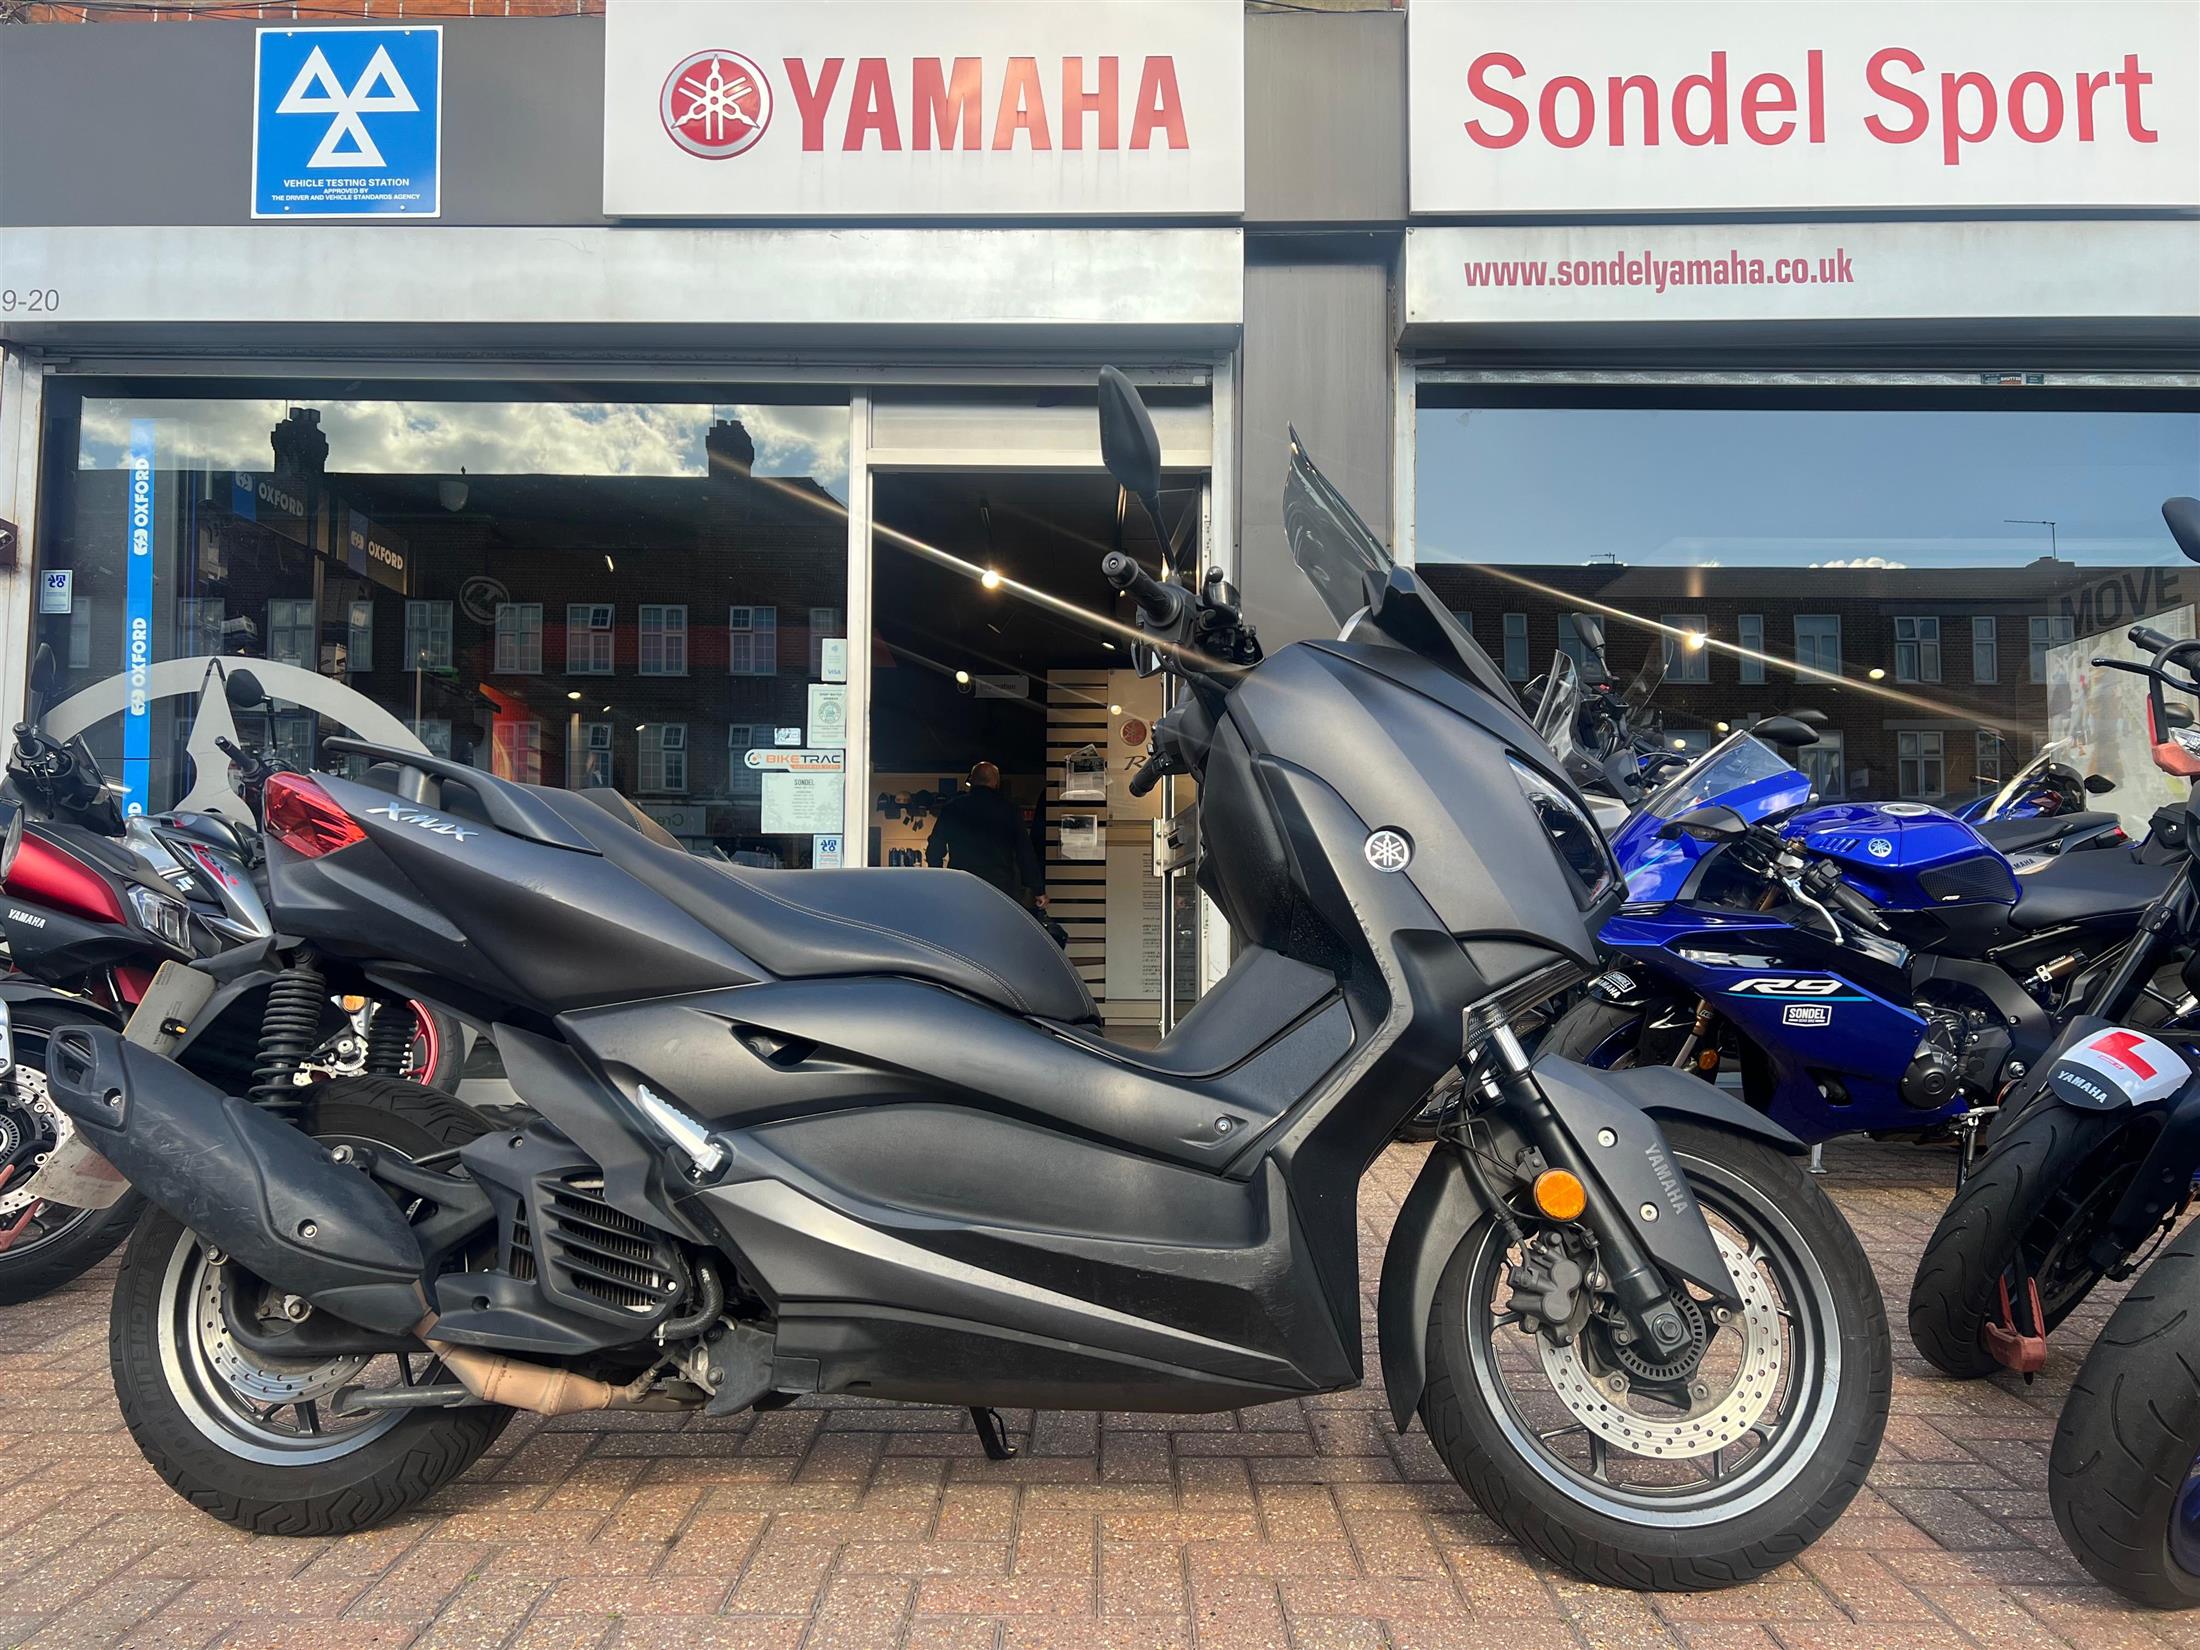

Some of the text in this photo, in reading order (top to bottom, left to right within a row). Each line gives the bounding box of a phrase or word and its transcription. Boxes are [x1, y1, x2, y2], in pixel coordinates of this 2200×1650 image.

[783, 55, 1190, 151] YAMAHA
[1463, 47, 2159, 166] Sondel Sport
[283, 178, 410, 188] VEHICLE TESTING STATION
[1463, 247, 1854, 294] www.sondelyamaha.co.uk
[134, 457, 149, 527] OXFORD
[258, 482, 304, 517] OXFORD
[368, 540, 403, 570] OXFORD
[2061, 567, 2183, 638] MOVE
[131, 617, 147, 687] OXFORD
[765, 755, 841, 764] BIKETRAC
[794, 778, 815, 786] SONDEL
[8, 908, 46, 929] YAMAHA
[1728, 978, 1843, 995] R9
[1788, 1007, 1826, 1020] SONDEL
[2057, 1070, 2108, 1104] YAMAHA
[1645, 1142, 1689, 1216] YAMAHA
[129, 1268, 164, 1404] MICHELIN
